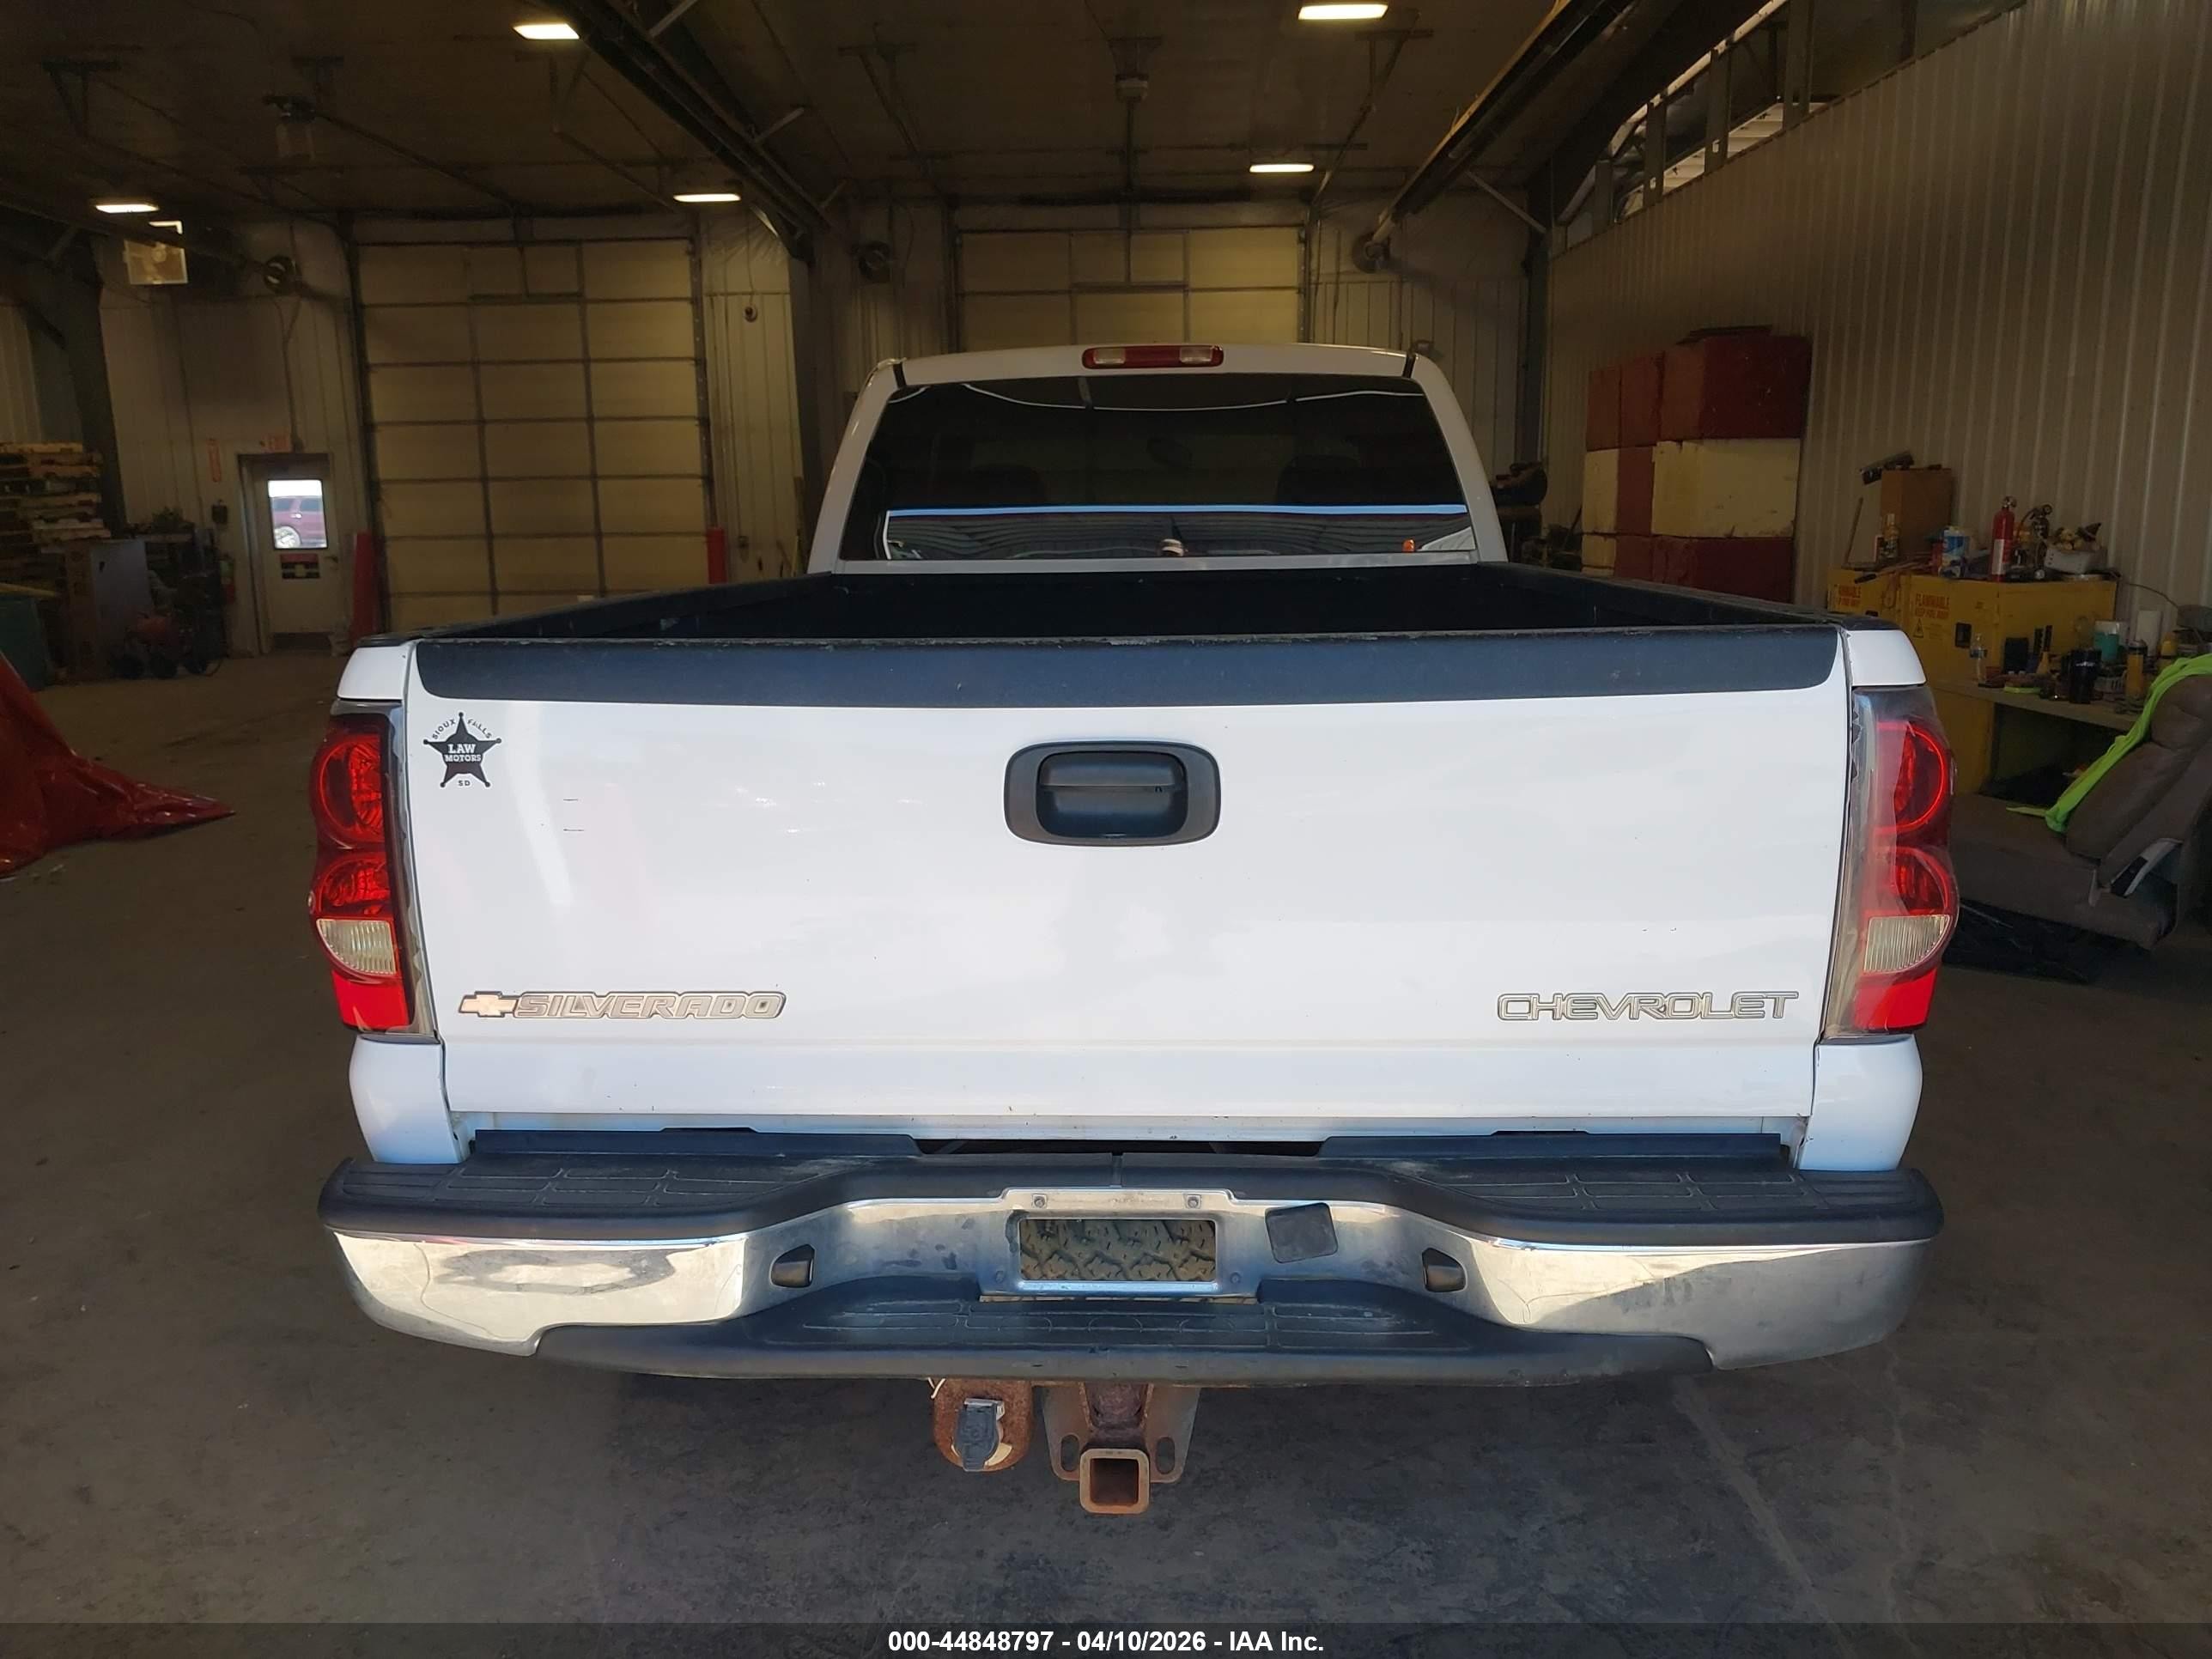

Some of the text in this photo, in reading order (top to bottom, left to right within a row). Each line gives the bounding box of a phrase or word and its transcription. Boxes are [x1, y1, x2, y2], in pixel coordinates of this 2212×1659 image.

[432, 719, 493, 739] SIOUX FALLS
[445, 754, 481, 763] MOTORS
[447, 744, 476, 754] LAW
[514, 991, 787, 1019] SILVERADO
[1498, 991, 1799, 1021] CHEVROLET
